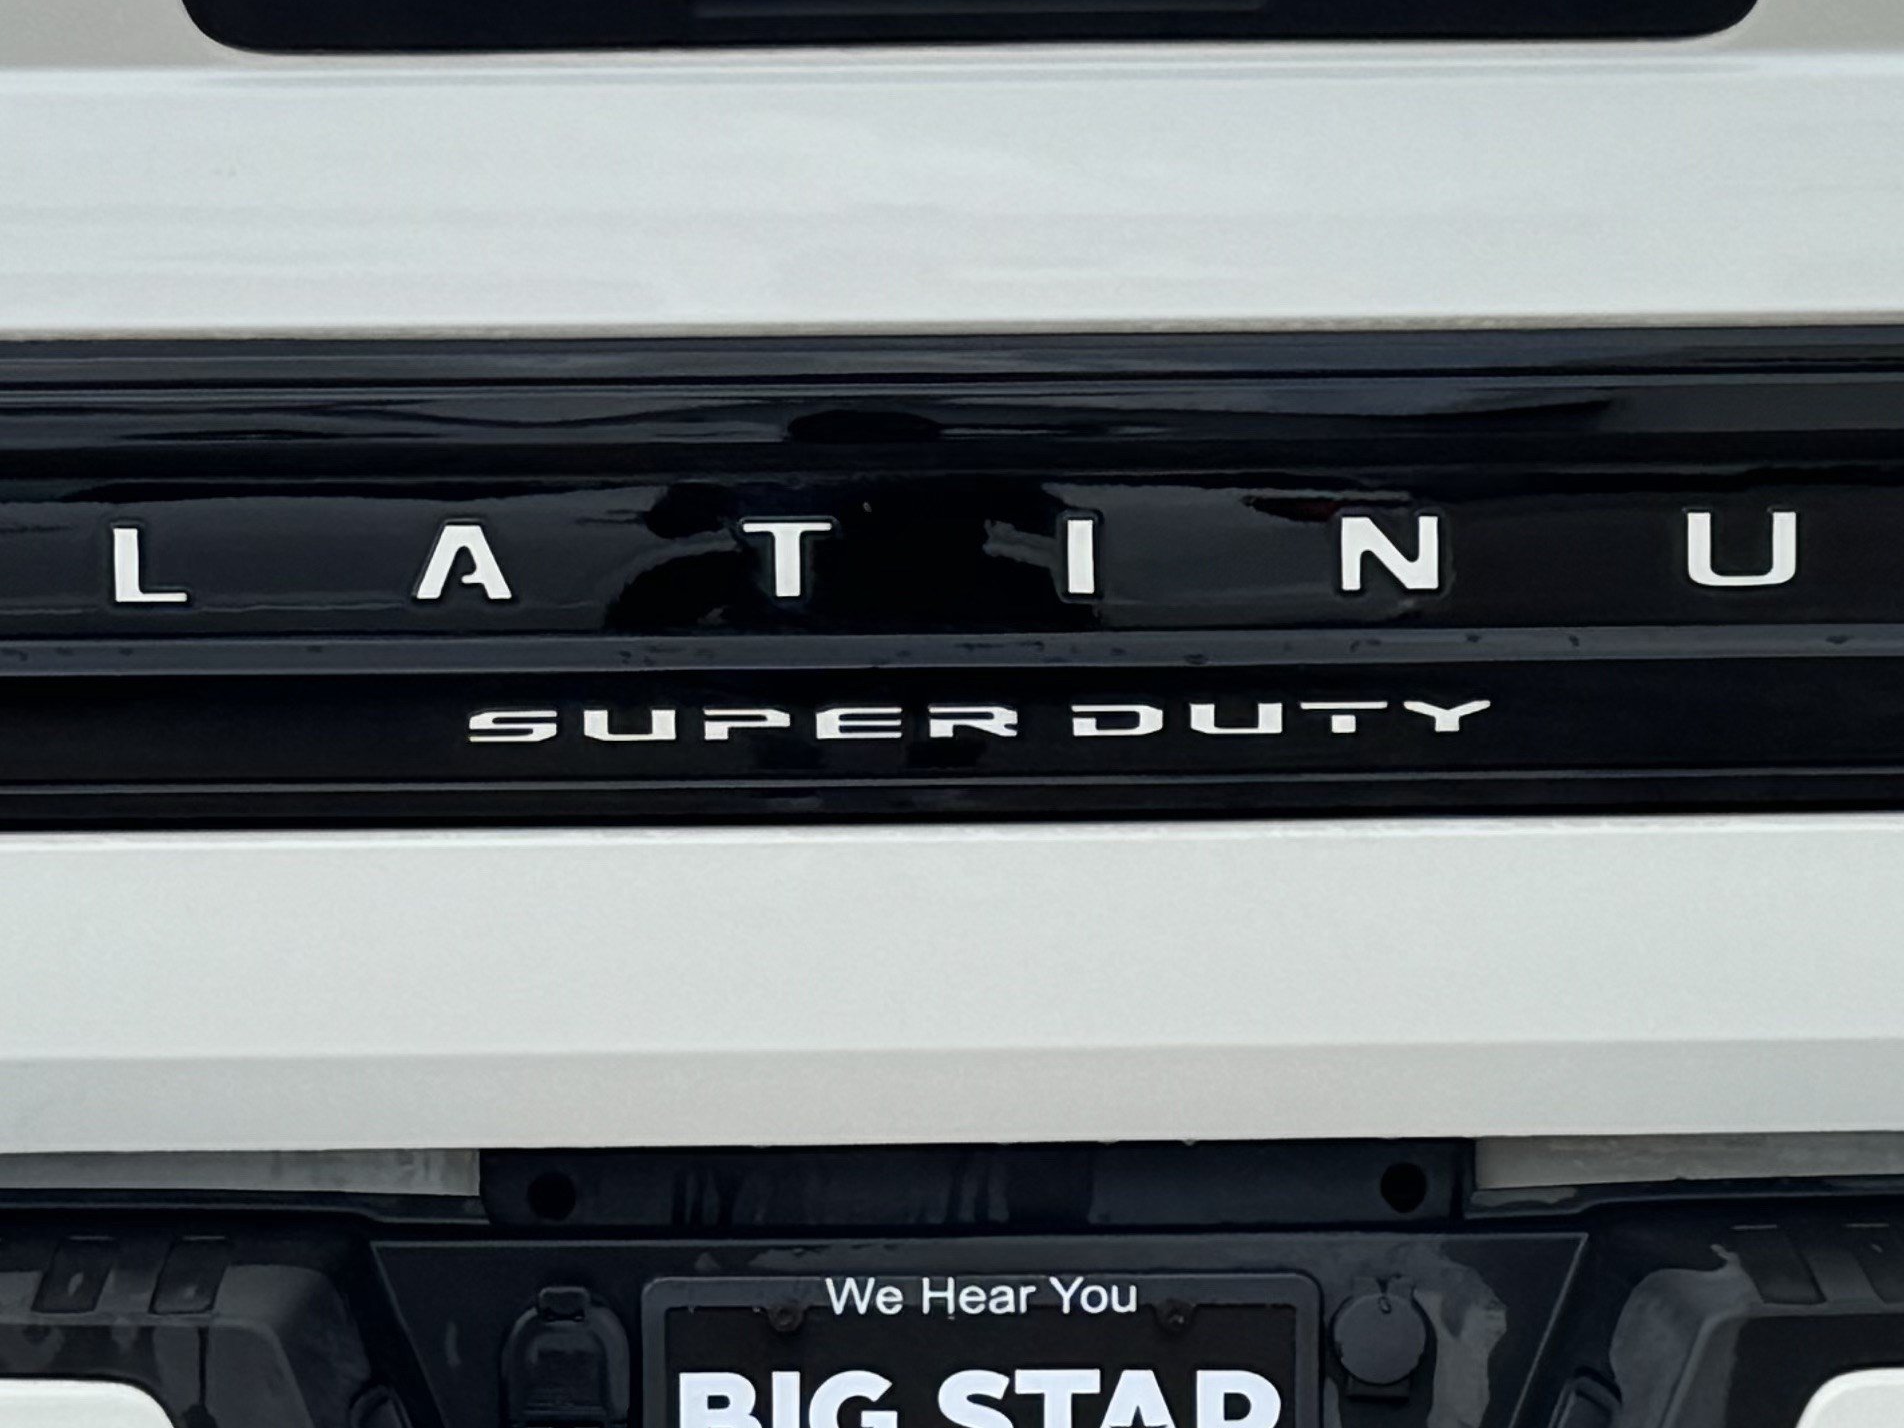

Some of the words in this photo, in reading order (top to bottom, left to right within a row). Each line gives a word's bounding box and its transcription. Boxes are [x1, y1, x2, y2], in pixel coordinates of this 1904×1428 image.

[469, 707, 1017, 741] SUPER
[1072, 699, 1492, 737] DUTY
[825, 1276, 903, 1315] We
[921, 1276, 1036, 1317] Hear
[1049, 1276, 1138, 1315] You
